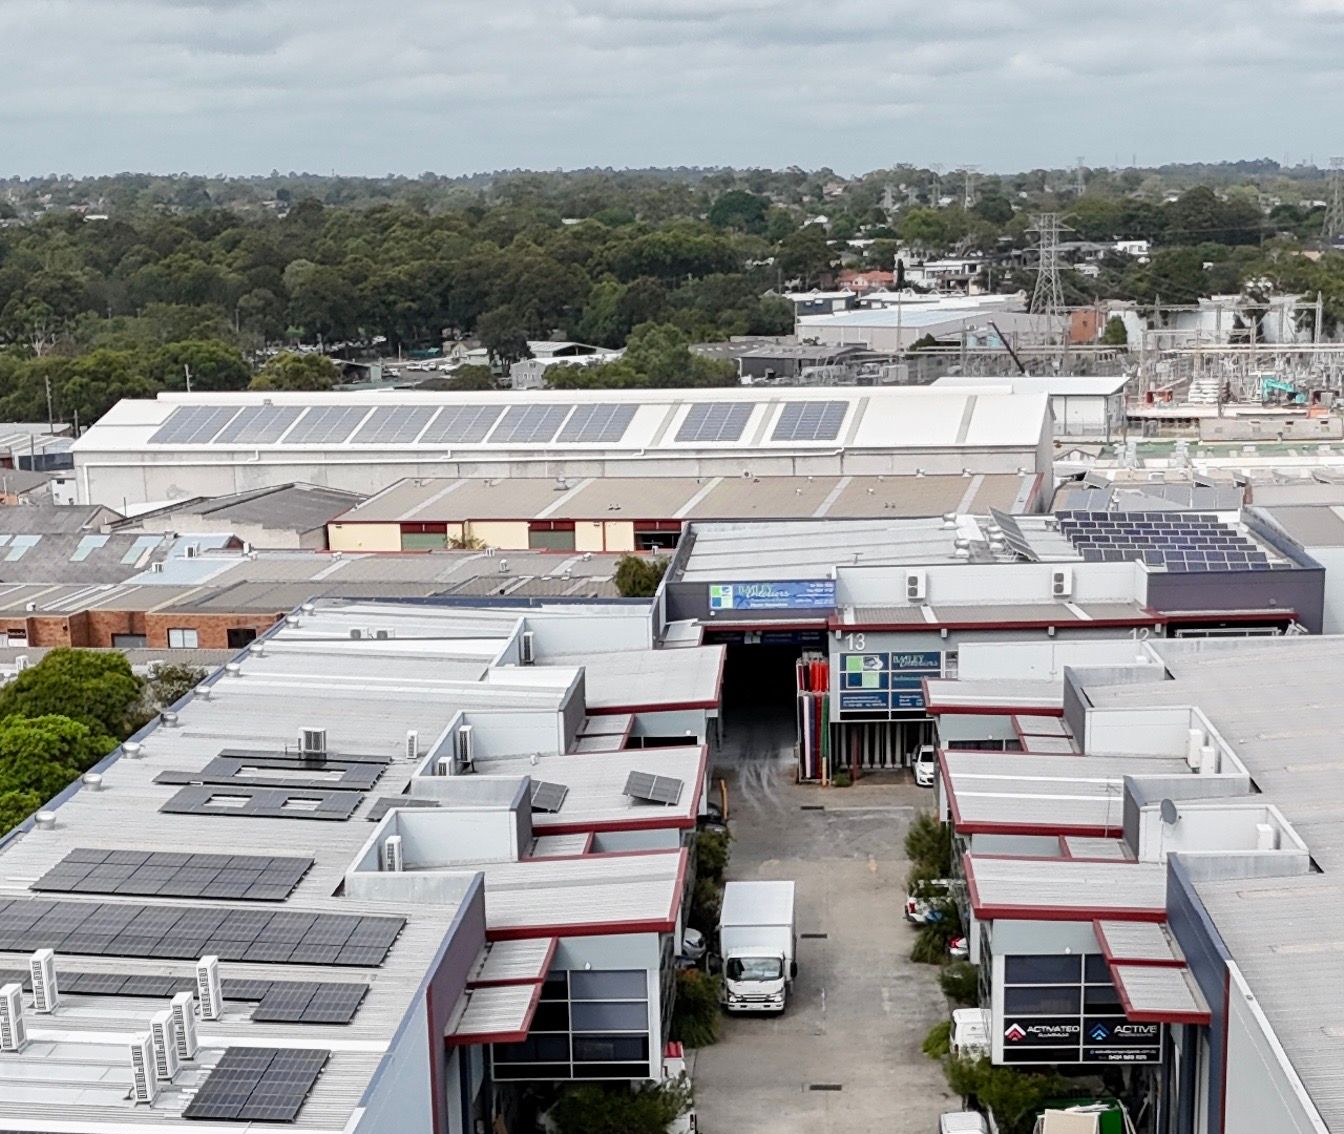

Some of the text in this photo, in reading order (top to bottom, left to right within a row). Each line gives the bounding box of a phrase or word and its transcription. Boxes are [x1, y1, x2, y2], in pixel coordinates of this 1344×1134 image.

[845, 633, 865, 650] 13
[1027, 1025, 1080, 1033] ACTIVATED
[1114, 1025, 1157, 1033] ACTIVE
